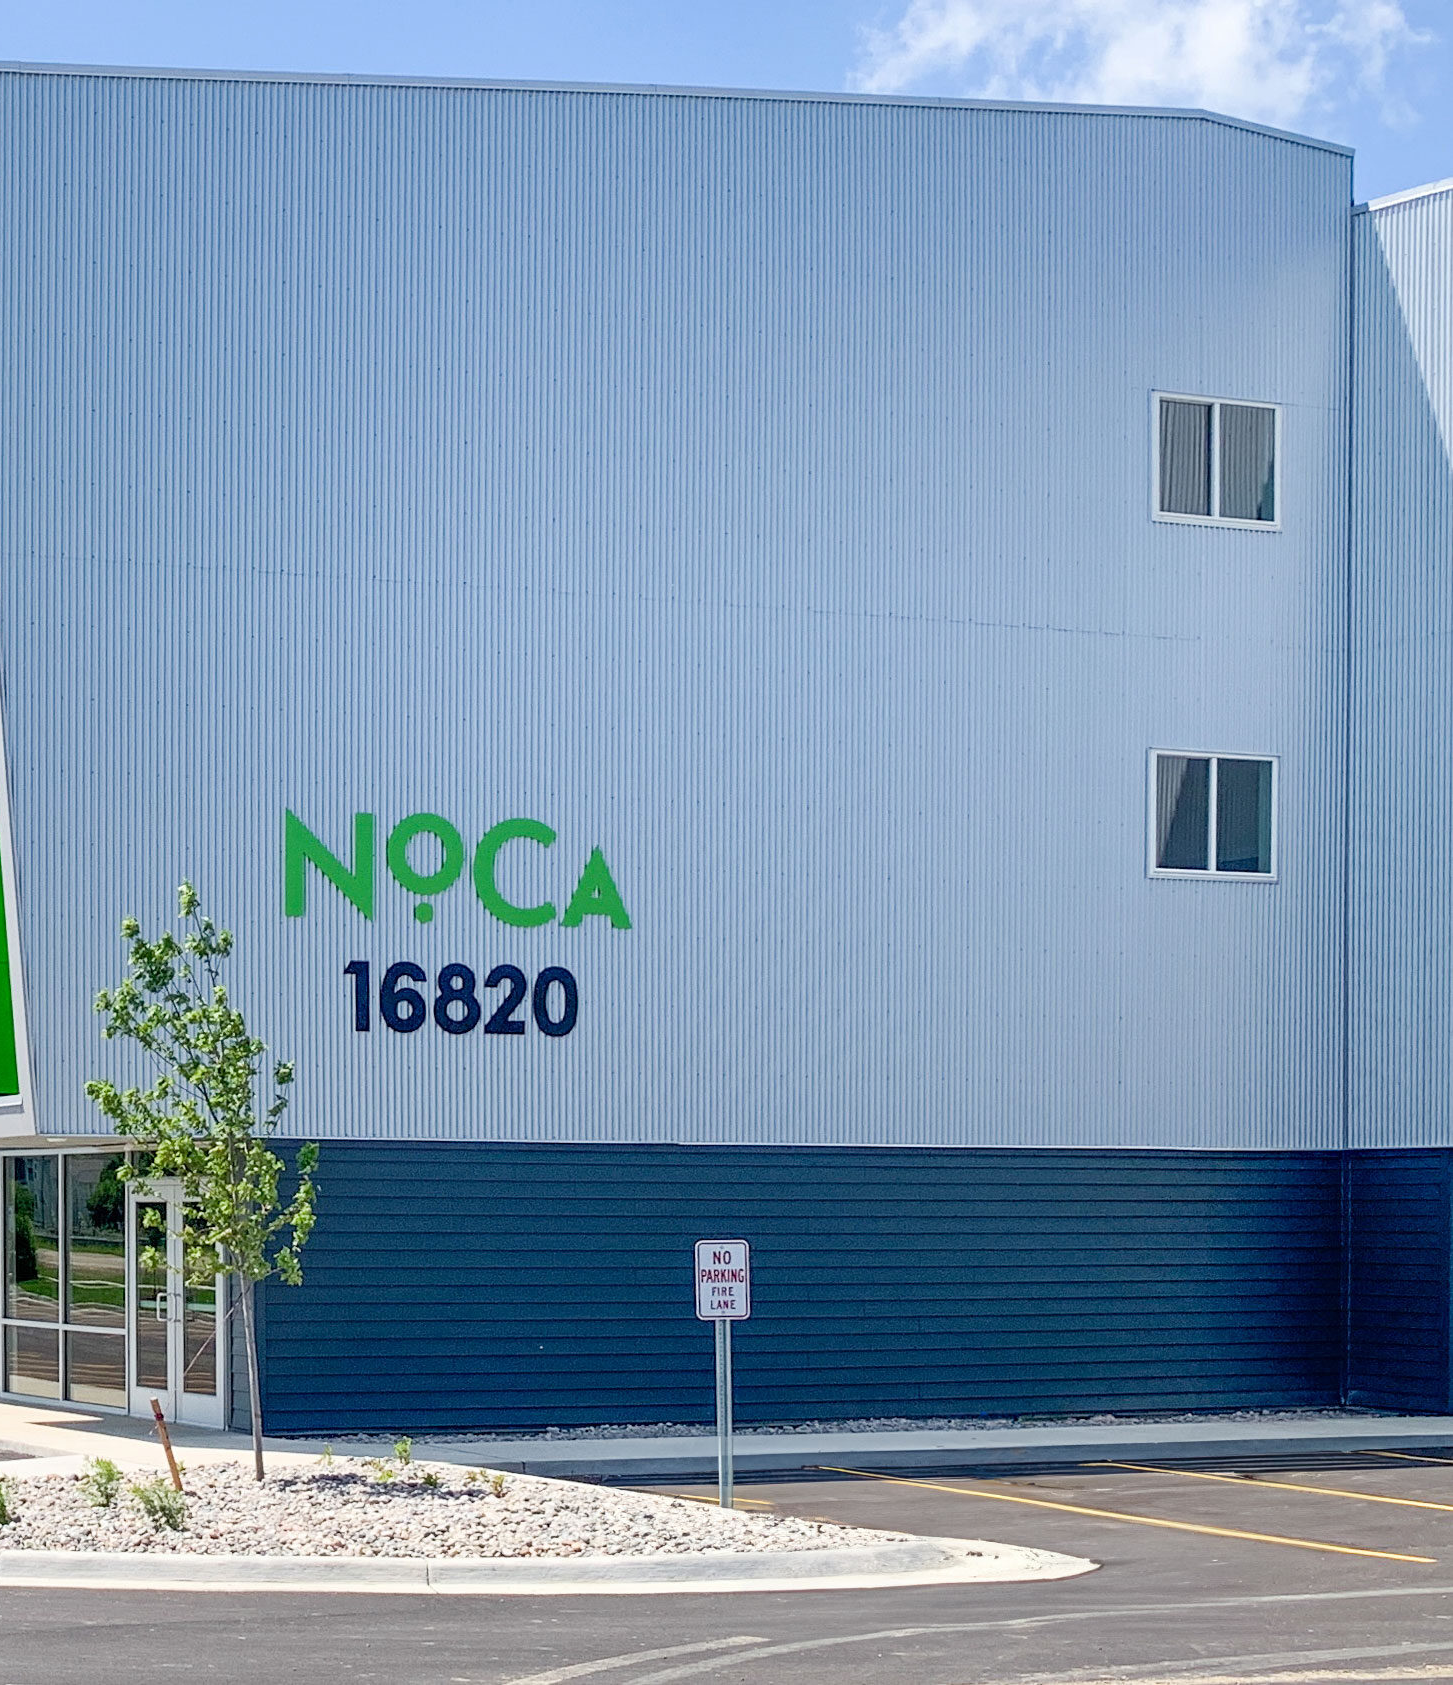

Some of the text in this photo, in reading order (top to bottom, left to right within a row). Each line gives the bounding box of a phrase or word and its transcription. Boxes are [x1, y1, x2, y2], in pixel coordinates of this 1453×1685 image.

[343, 960, 579, 1037] 16820
[712, 1250, 732, 1265] NO
[700, 1268, 745, 1283] PARKING
[711, 1286, 734, 1297] FIRE
[710, 1299, 736, 1310] LANE
